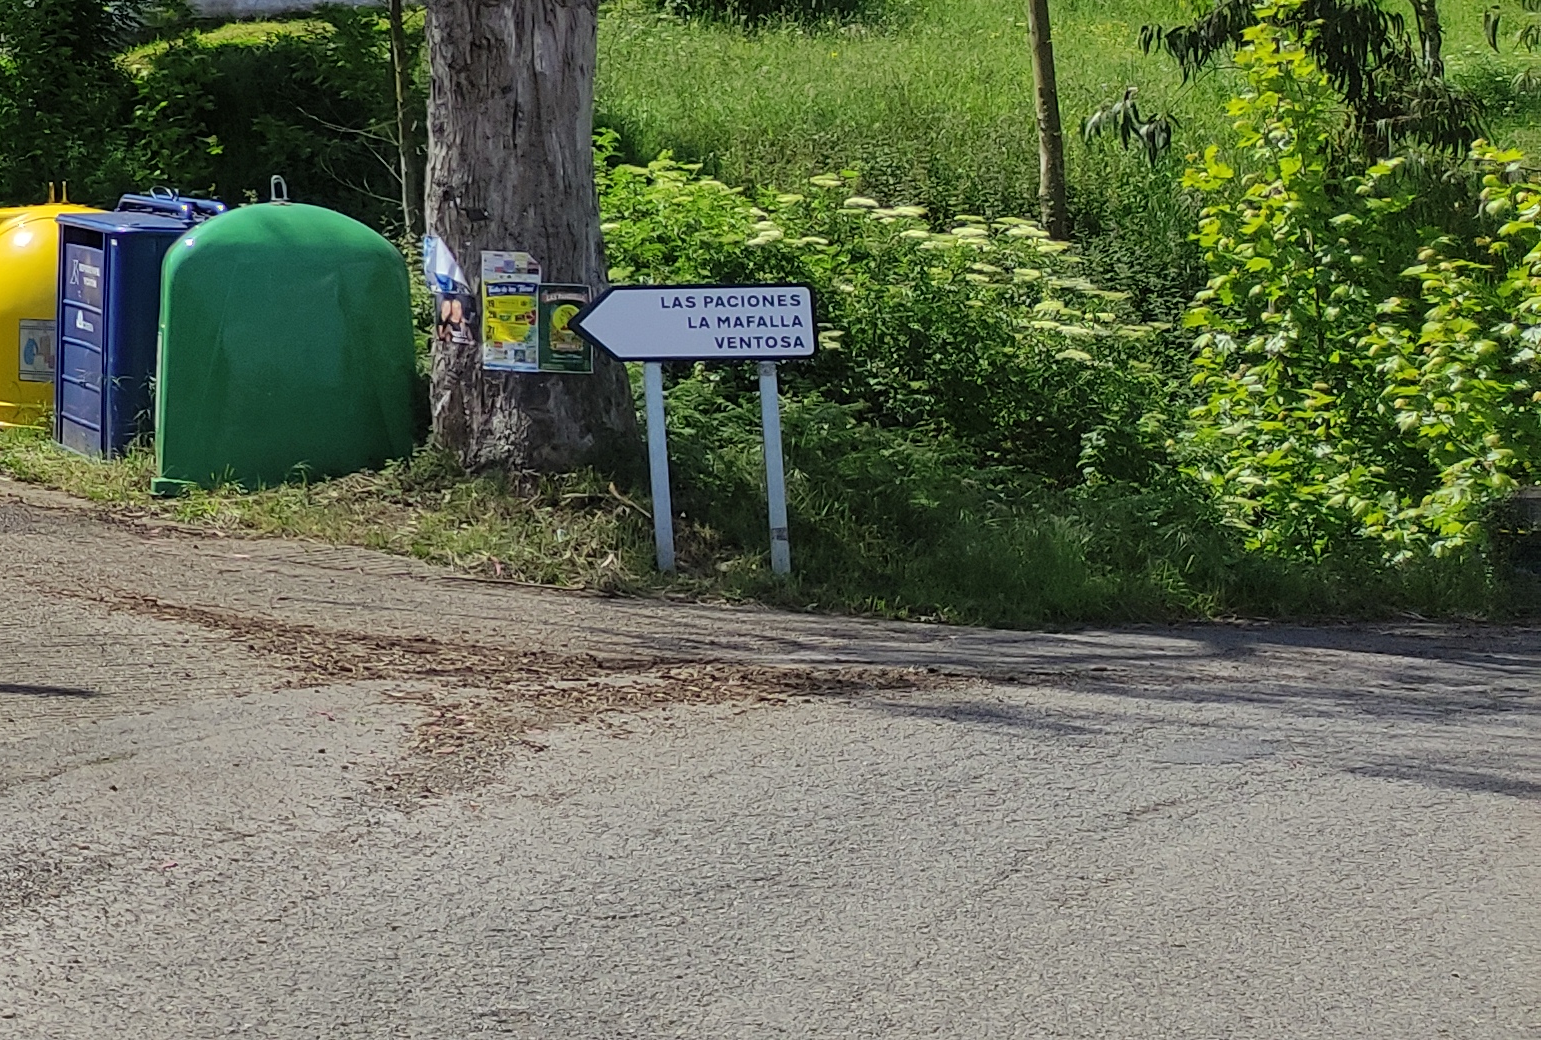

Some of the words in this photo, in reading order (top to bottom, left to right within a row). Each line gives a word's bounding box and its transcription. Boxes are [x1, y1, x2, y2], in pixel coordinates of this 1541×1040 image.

[660, 295, 697, 309] LAS
[703, 294, 802, 308] PACIONES
[687, 316, 710, 329] LA
[717, 315, 804, 329] MAFALLA
[714, 336, 805, 349] VENTOSA
